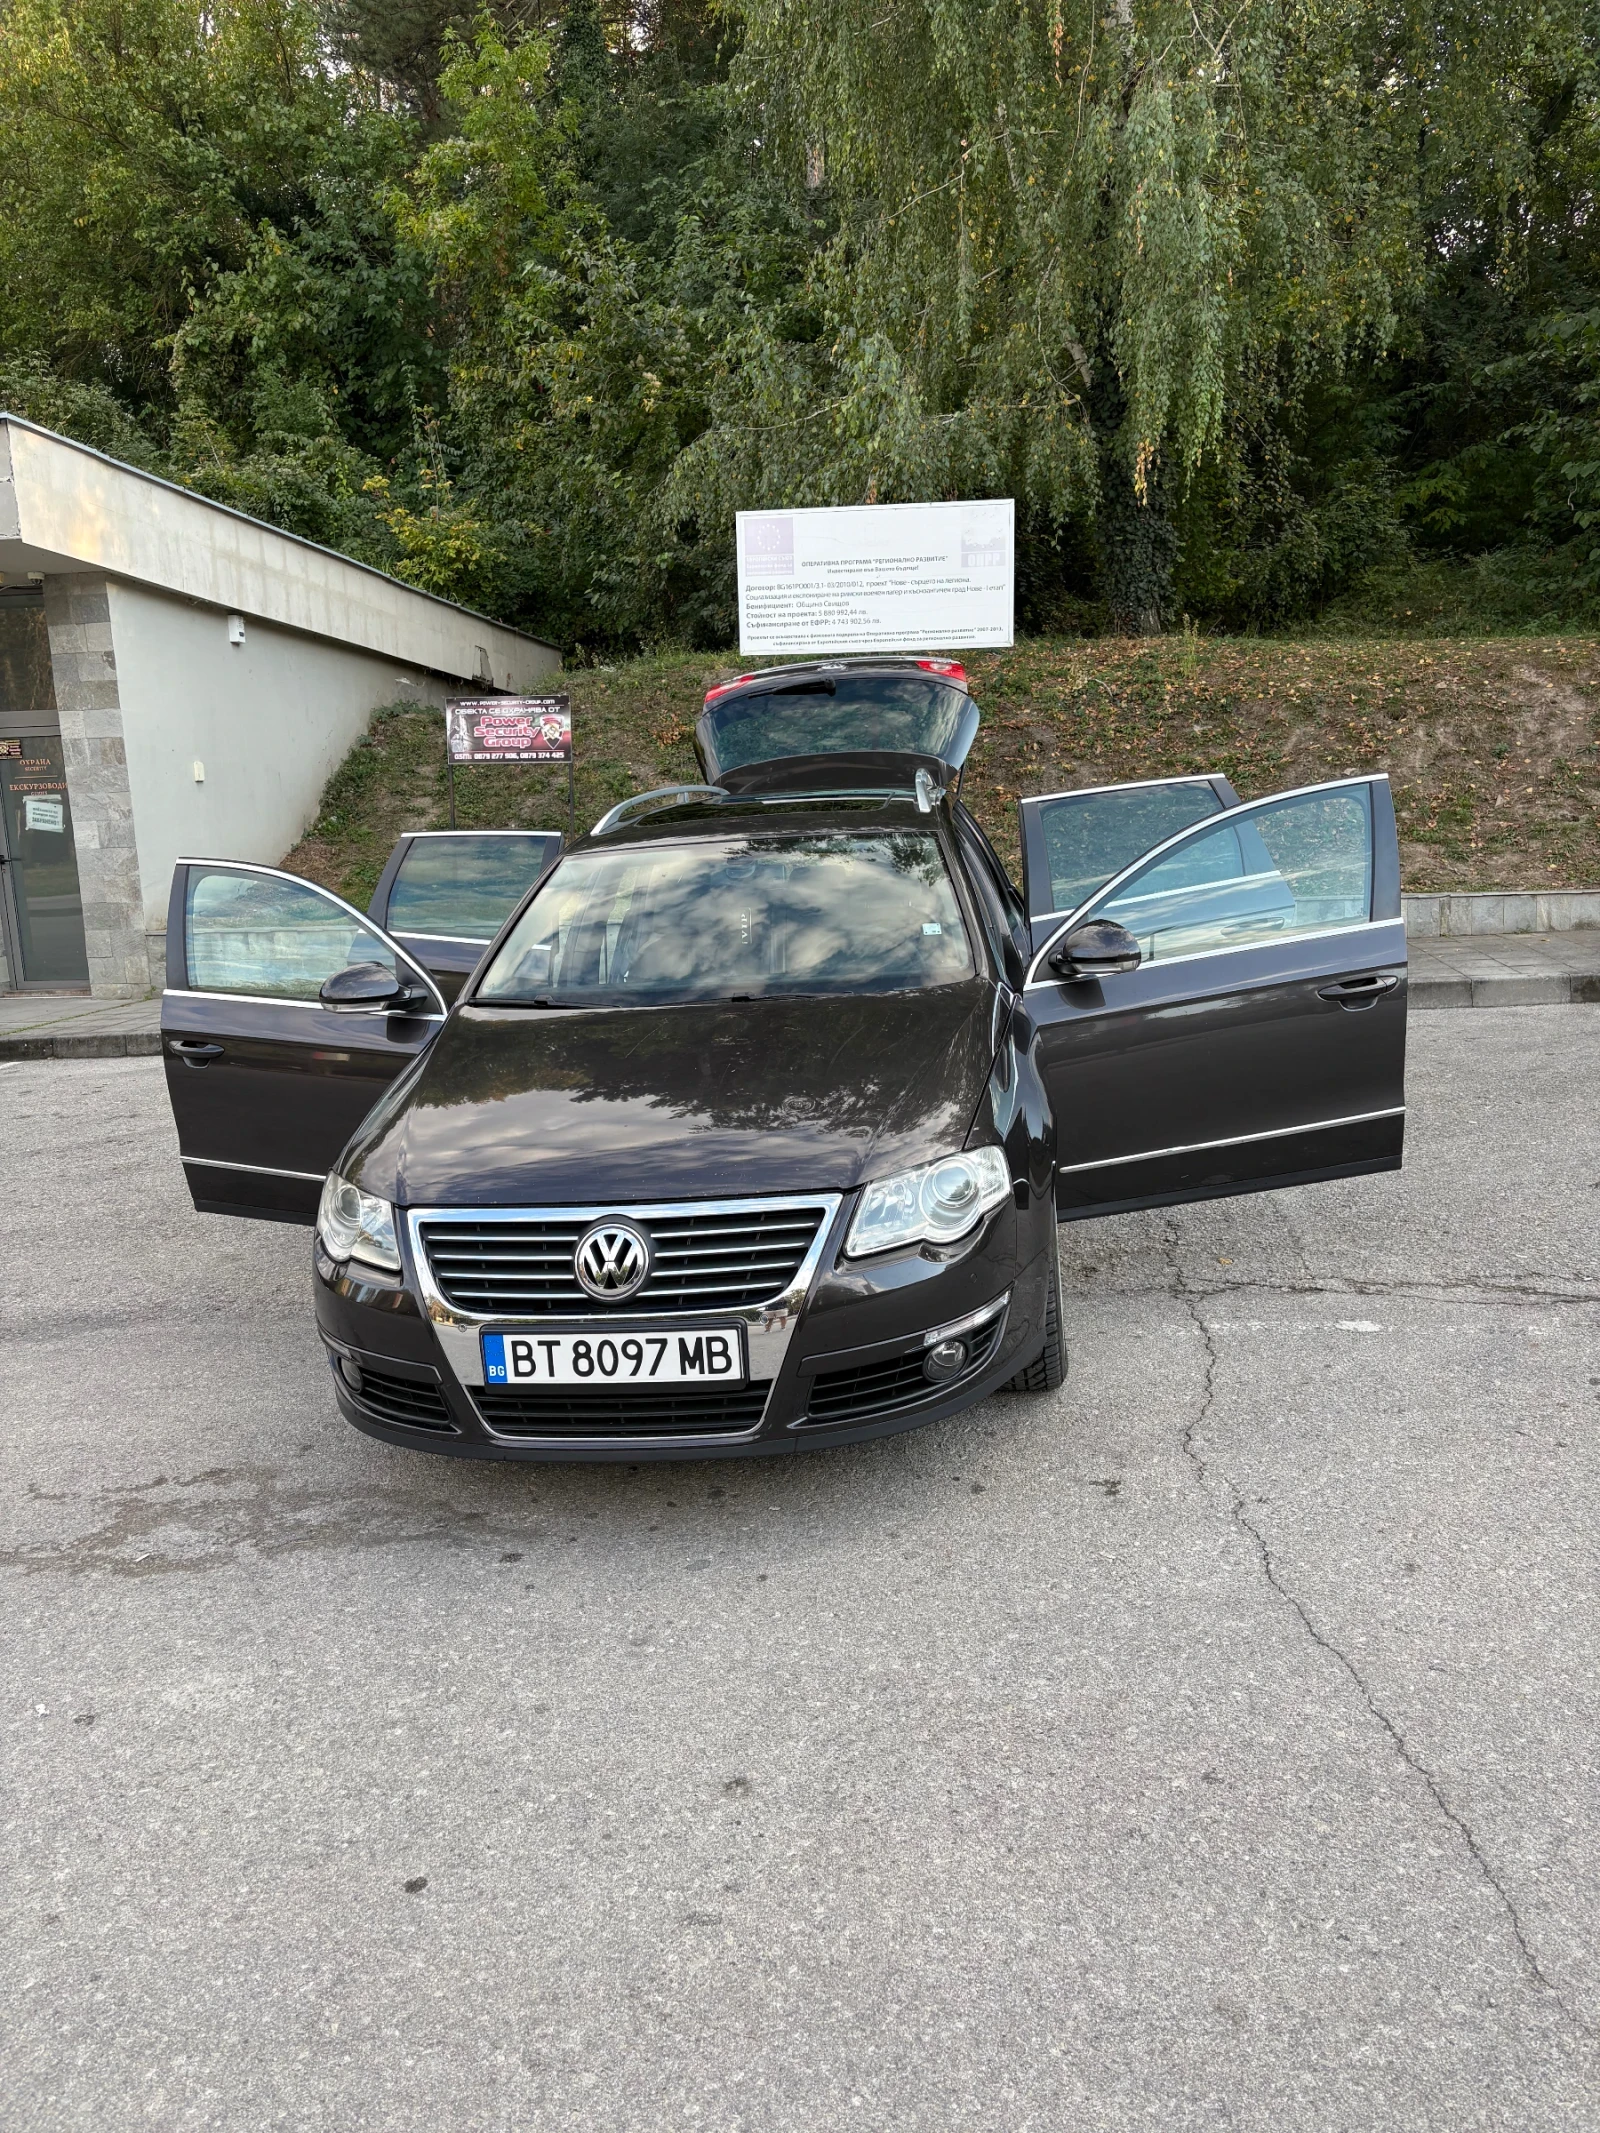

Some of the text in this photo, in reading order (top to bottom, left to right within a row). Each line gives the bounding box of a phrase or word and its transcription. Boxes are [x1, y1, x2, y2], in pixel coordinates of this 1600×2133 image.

[840, 558, 872, 566] ПРОГРАМА
[796, 600, 823, 609] Община
[745, 611, 777, 619] Стойност
[787, 611, 818, 619] проекта:
[810, 618, 831, 626] ЕФРР:
[454, 707, 488, 715] ОБЕКТА
[488, 707, 501, 715] СЕ
[547, 705, 561, 713] ОТ
[480, 715, 533, 727] Power
[473, 725, 541, 738] Security
[483, 736, 532, 749] Group
[19, 758, 51, 766] ОХРАНА
[511, 1336, 732, 1378] BT 8097 MB
[489, 1365, 505, 1377] BG
